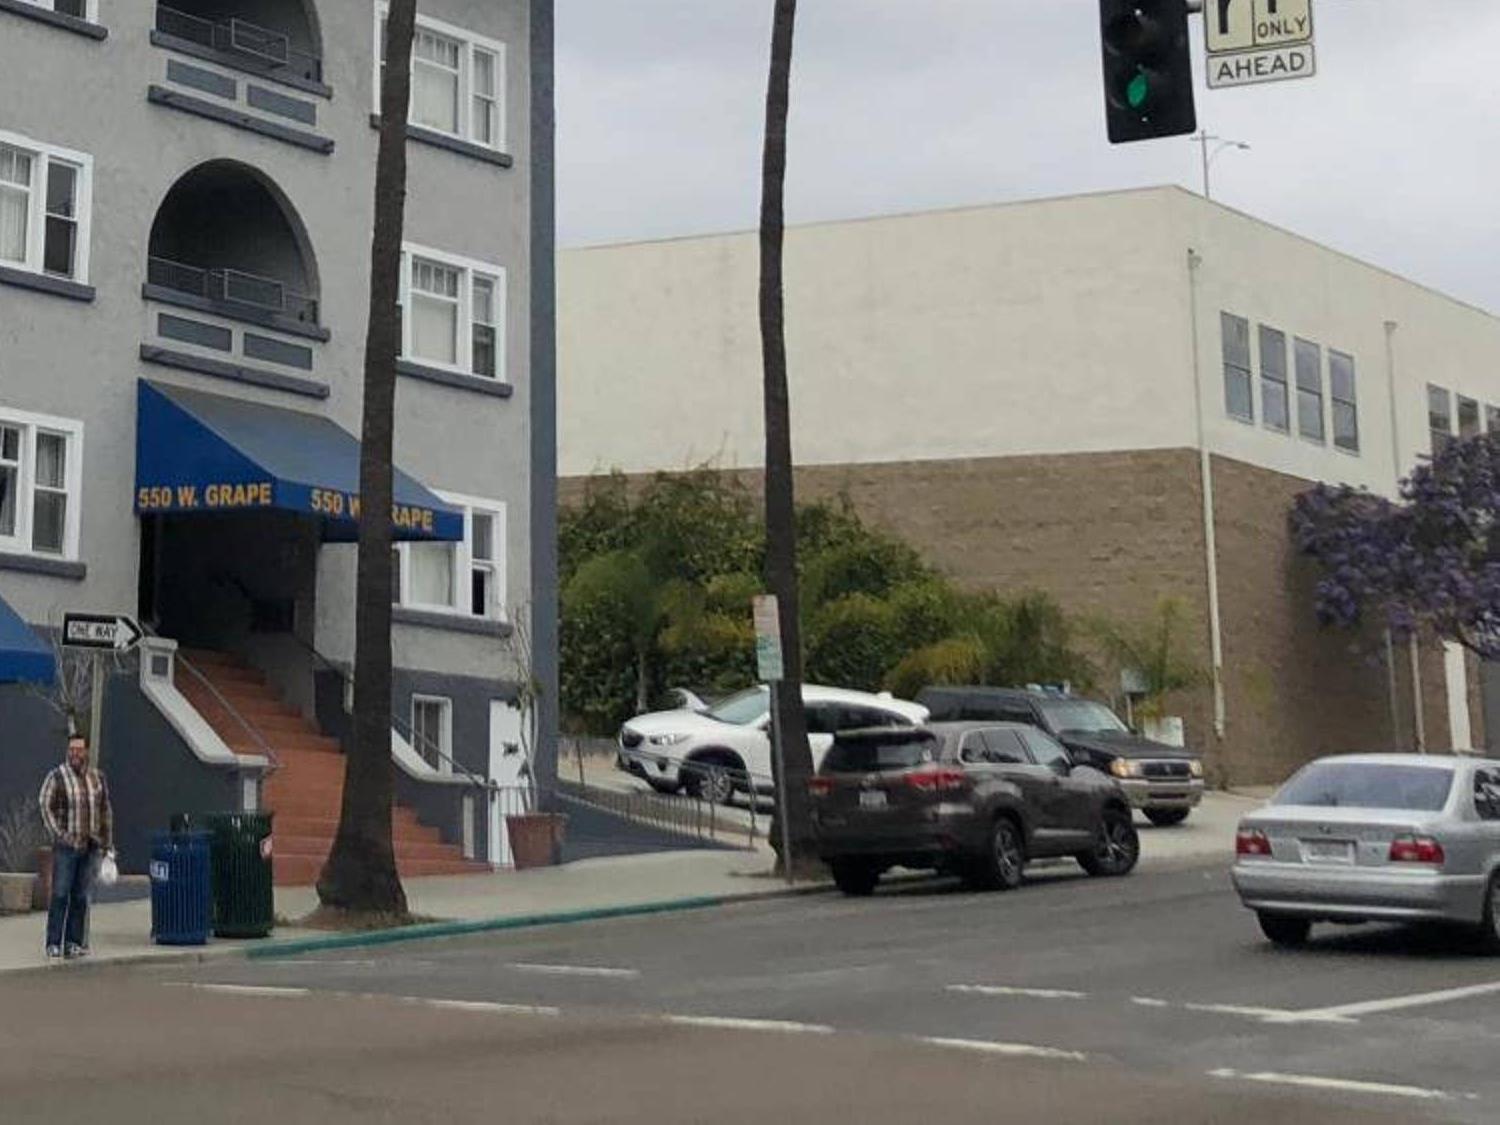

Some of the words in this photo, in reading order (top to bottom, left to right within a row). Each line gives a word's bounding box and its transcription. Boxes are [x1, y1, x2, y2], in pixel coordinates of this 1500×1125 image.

[1257, 17, 1308, 39] ONLY
[1216, 52, 1306, 81] AHEAD
[138, 486, 172, 508] 550
[177, 485, 199, 507] W.
[205, 482, 272, 507] GRAPE
[311, 487, 343, 515] 550
[348, 495, 361, 519] W
[391, 505, 433, 532] RAPE
[69, 622, 92, 638] ONE
[94, 623, 118, 639] WAY
